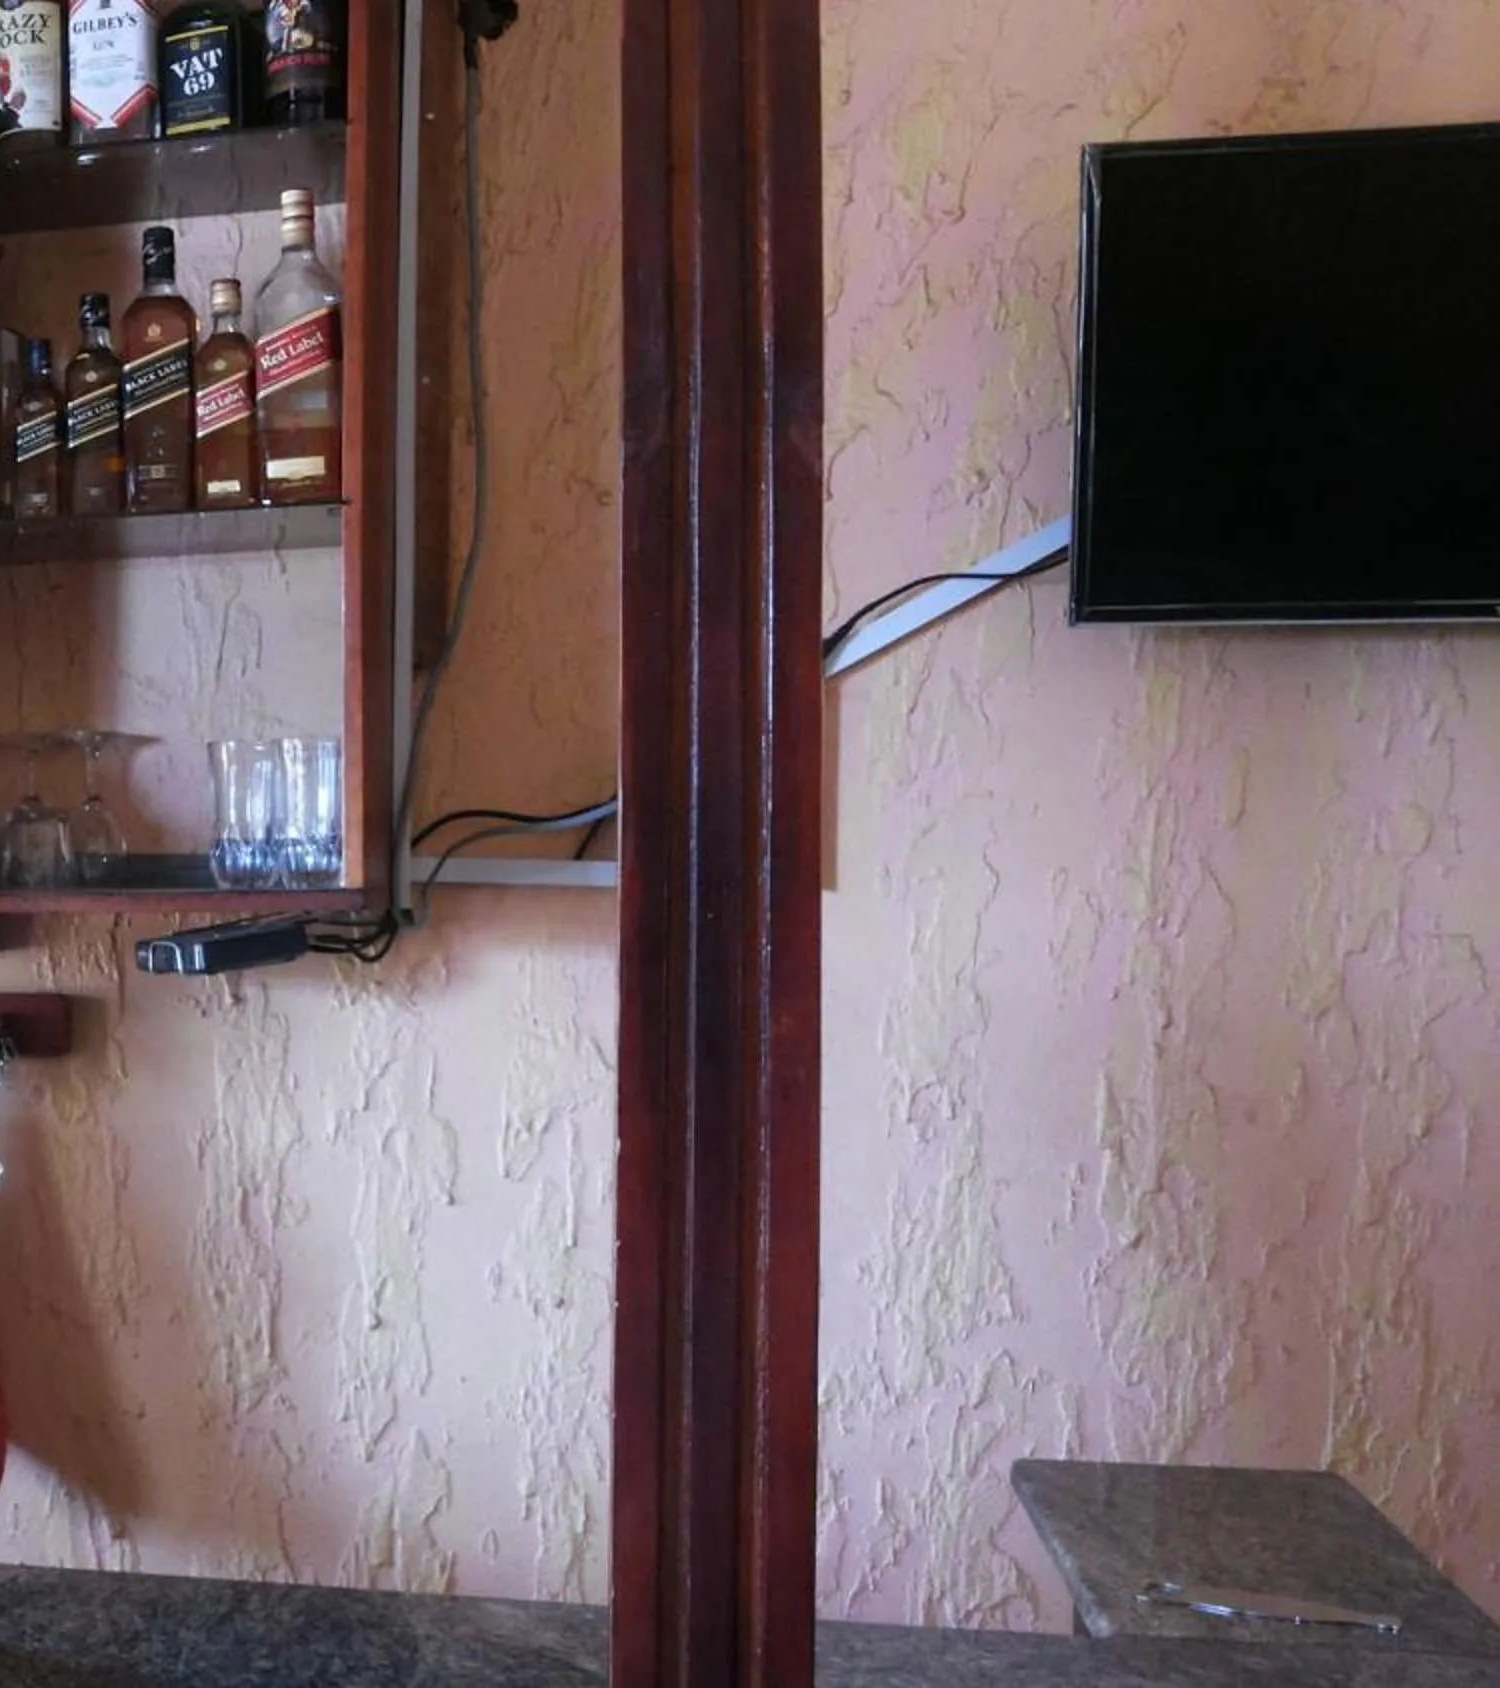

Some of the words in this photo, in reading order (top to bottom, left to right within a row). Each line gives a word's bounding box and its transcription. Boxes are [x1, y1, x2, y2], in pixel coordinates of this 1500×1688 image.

[0, 30, 48, 48] OCK
[169, 47, 224, 79] VAT
[183, 72, 215, 96] 69
[260, 347, 288, 369] Red
[288, 331, 324, 357] Label
